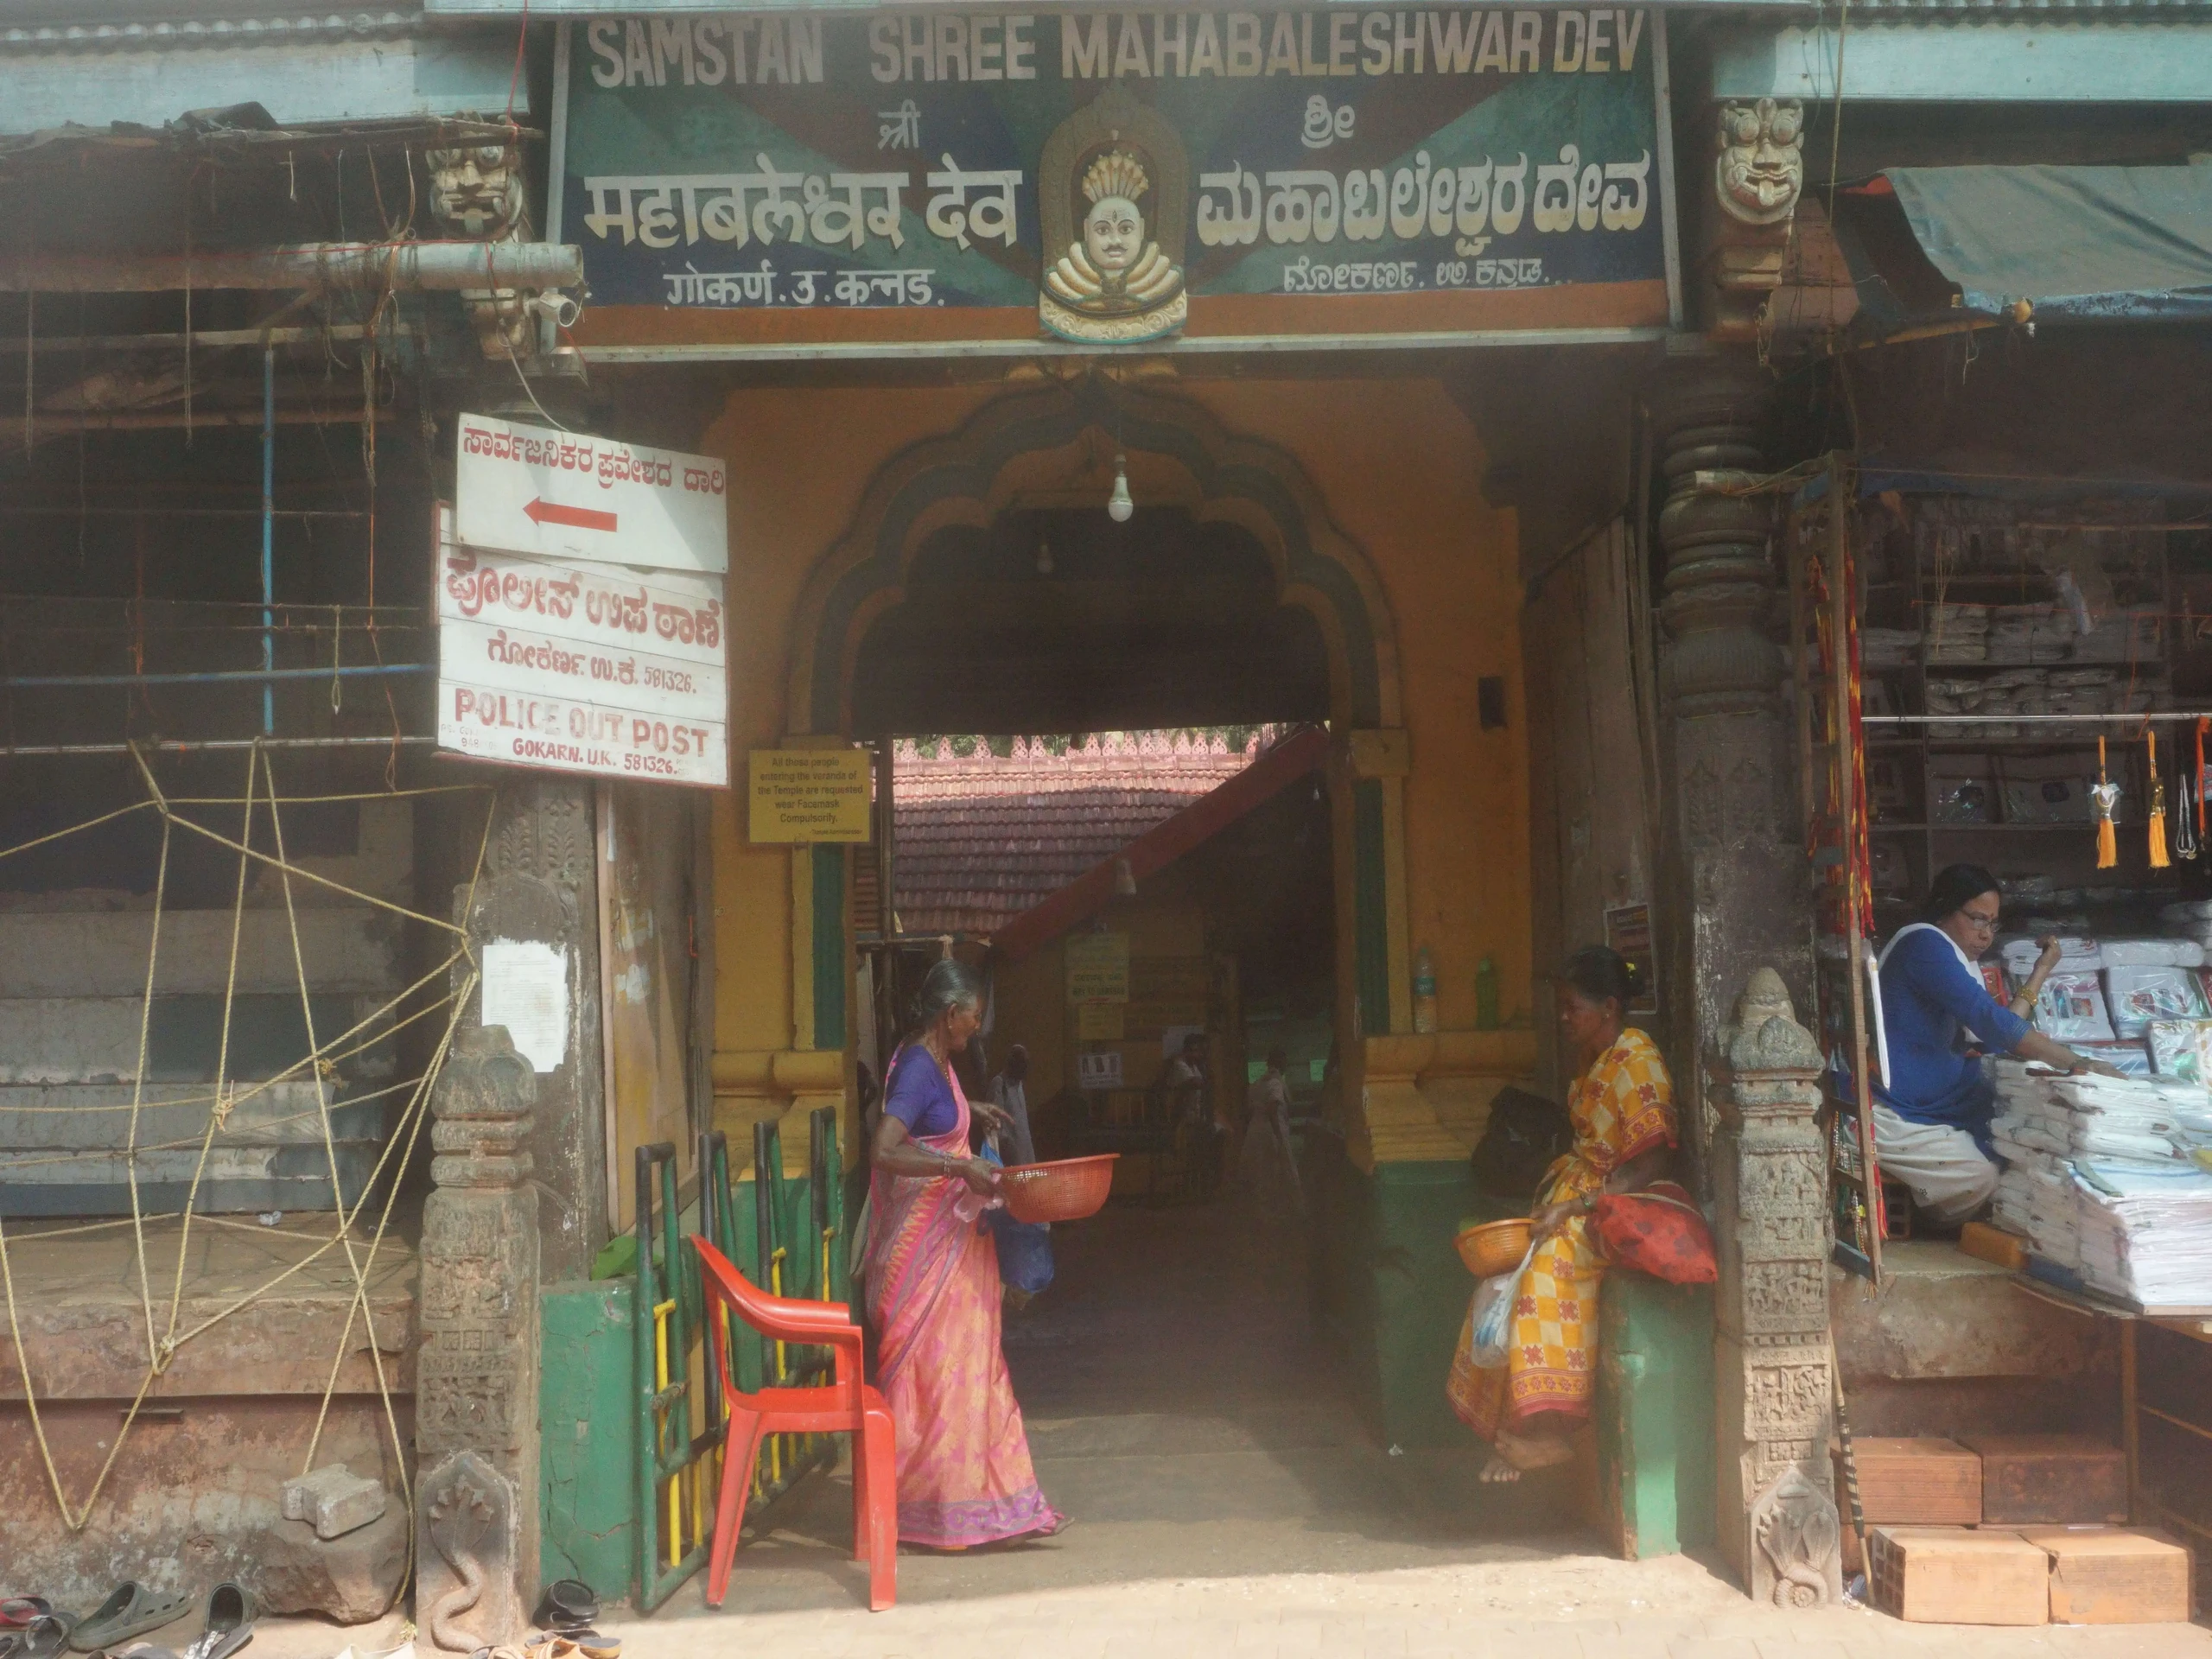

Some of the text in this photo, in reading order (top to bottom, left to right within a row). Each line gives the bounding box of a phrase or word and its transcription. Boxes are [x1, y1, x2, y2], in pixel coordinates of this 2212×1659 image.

[588, 10, 1645, 88] SAMSTAN SHREE MAHABALESHWAR DEV
[876, 99, 921, 150] श्री
[1300, 94, 1355, 149] ಶ್ರೀ
[583, 152, 1023, 251] महाबलेश्वर देव
[1196, 143, 1650, 257] ಮಹಾಬಲೇಶ್ವರ ದೇವ
[463, 426, 725, 495] ಸಾರ್ವಜನಿಕರ ಪ್ರವೇಶದ ದಾರಿ
[585, 586, 648, 634] ಉಪ
[652, 598, 721, 649] ಠಾಣೆ
[454, 688, 709, 758] POLICE OUT POST
[758, 786, 771, 795] the
[774, 785, 804, 797] Temple
[822, 785, 863, 798] requested
[760, 772, 794, 784] entering
[798, 772, 810, 781] the
[849, 771, 857, 781] of
[811, 757, 839, 769] people
[798, 800, 839, 810] Facemask
